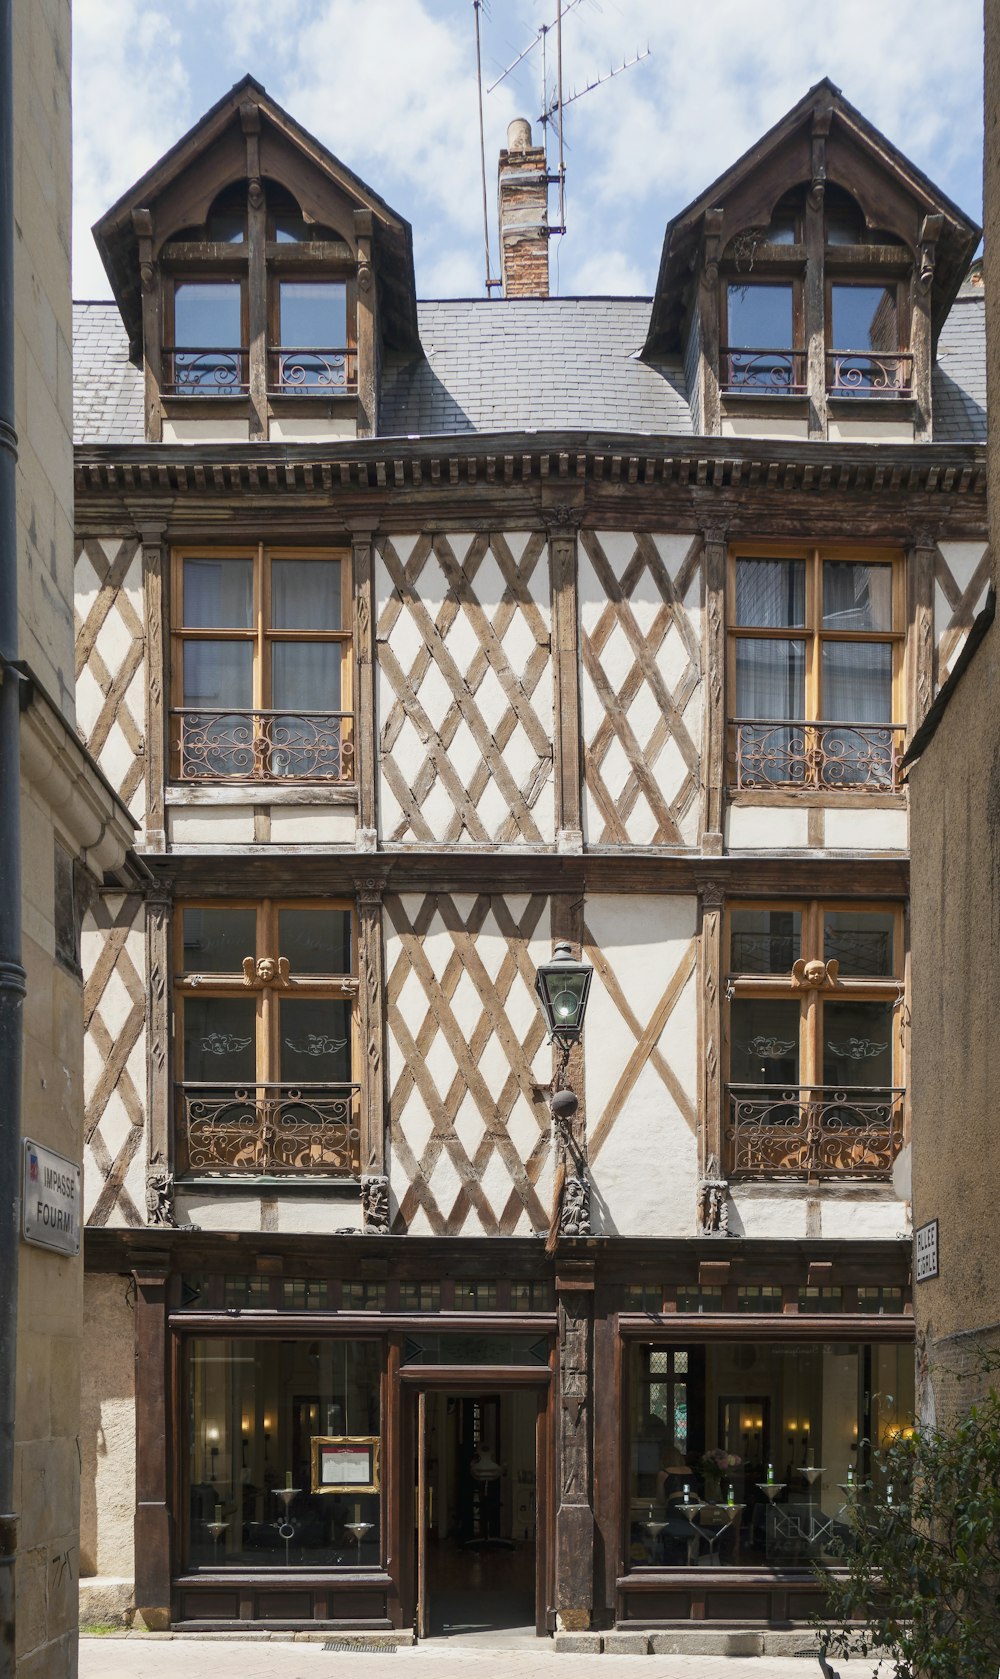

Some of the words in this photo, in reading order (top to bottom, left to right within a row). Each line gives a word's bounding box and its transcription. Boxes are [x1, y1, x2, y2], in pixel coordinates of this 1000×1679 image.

[44, 1166, 75, 1199] IMPASSE
[37, 1201, 73, 1234] FOURMI
[918, 1226, 935, 1252] ALLEE
